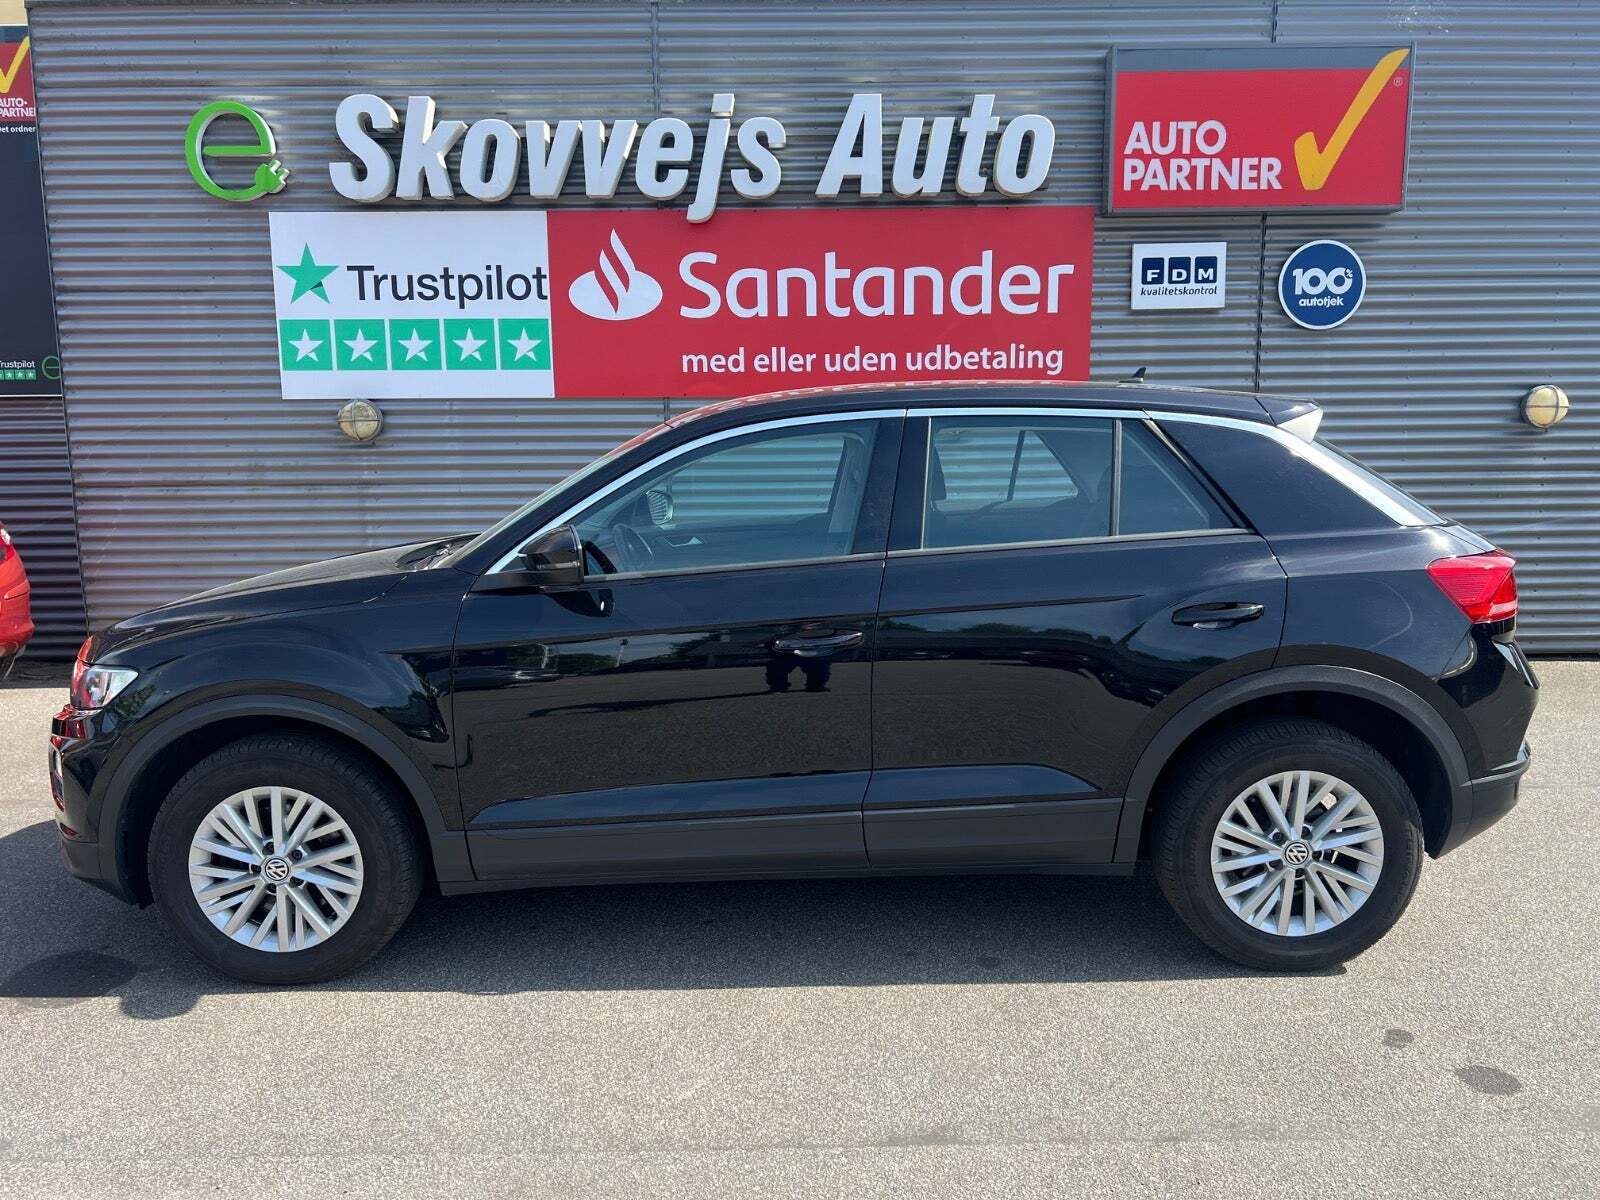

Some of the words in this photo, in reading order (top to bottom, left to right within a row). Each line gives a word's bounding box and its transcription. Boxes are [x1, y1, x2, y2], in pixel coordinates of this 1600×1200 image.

[10, 124, 36, 133] ordner
[1123, 119, 1227, 155] AUTO
[329, 93, 787, 223] Skovvejs
[815, 93, 1057, 198] Auto
[1123, 157, 1283, 191] PARTNER
[346, 264, 548, 309] Trustpilot
[678, 250, 1075, 319] Santander
[1140, 286, 1218, 296] kvalitetskontrol
[1298, 295, 1344, 308] autotjek
[682, 346, 746, 373] med
[753, 346, 817, 372] eller
[824, 345, 897, 372] uden
[905, 344, 1064, 376] udbetaling
